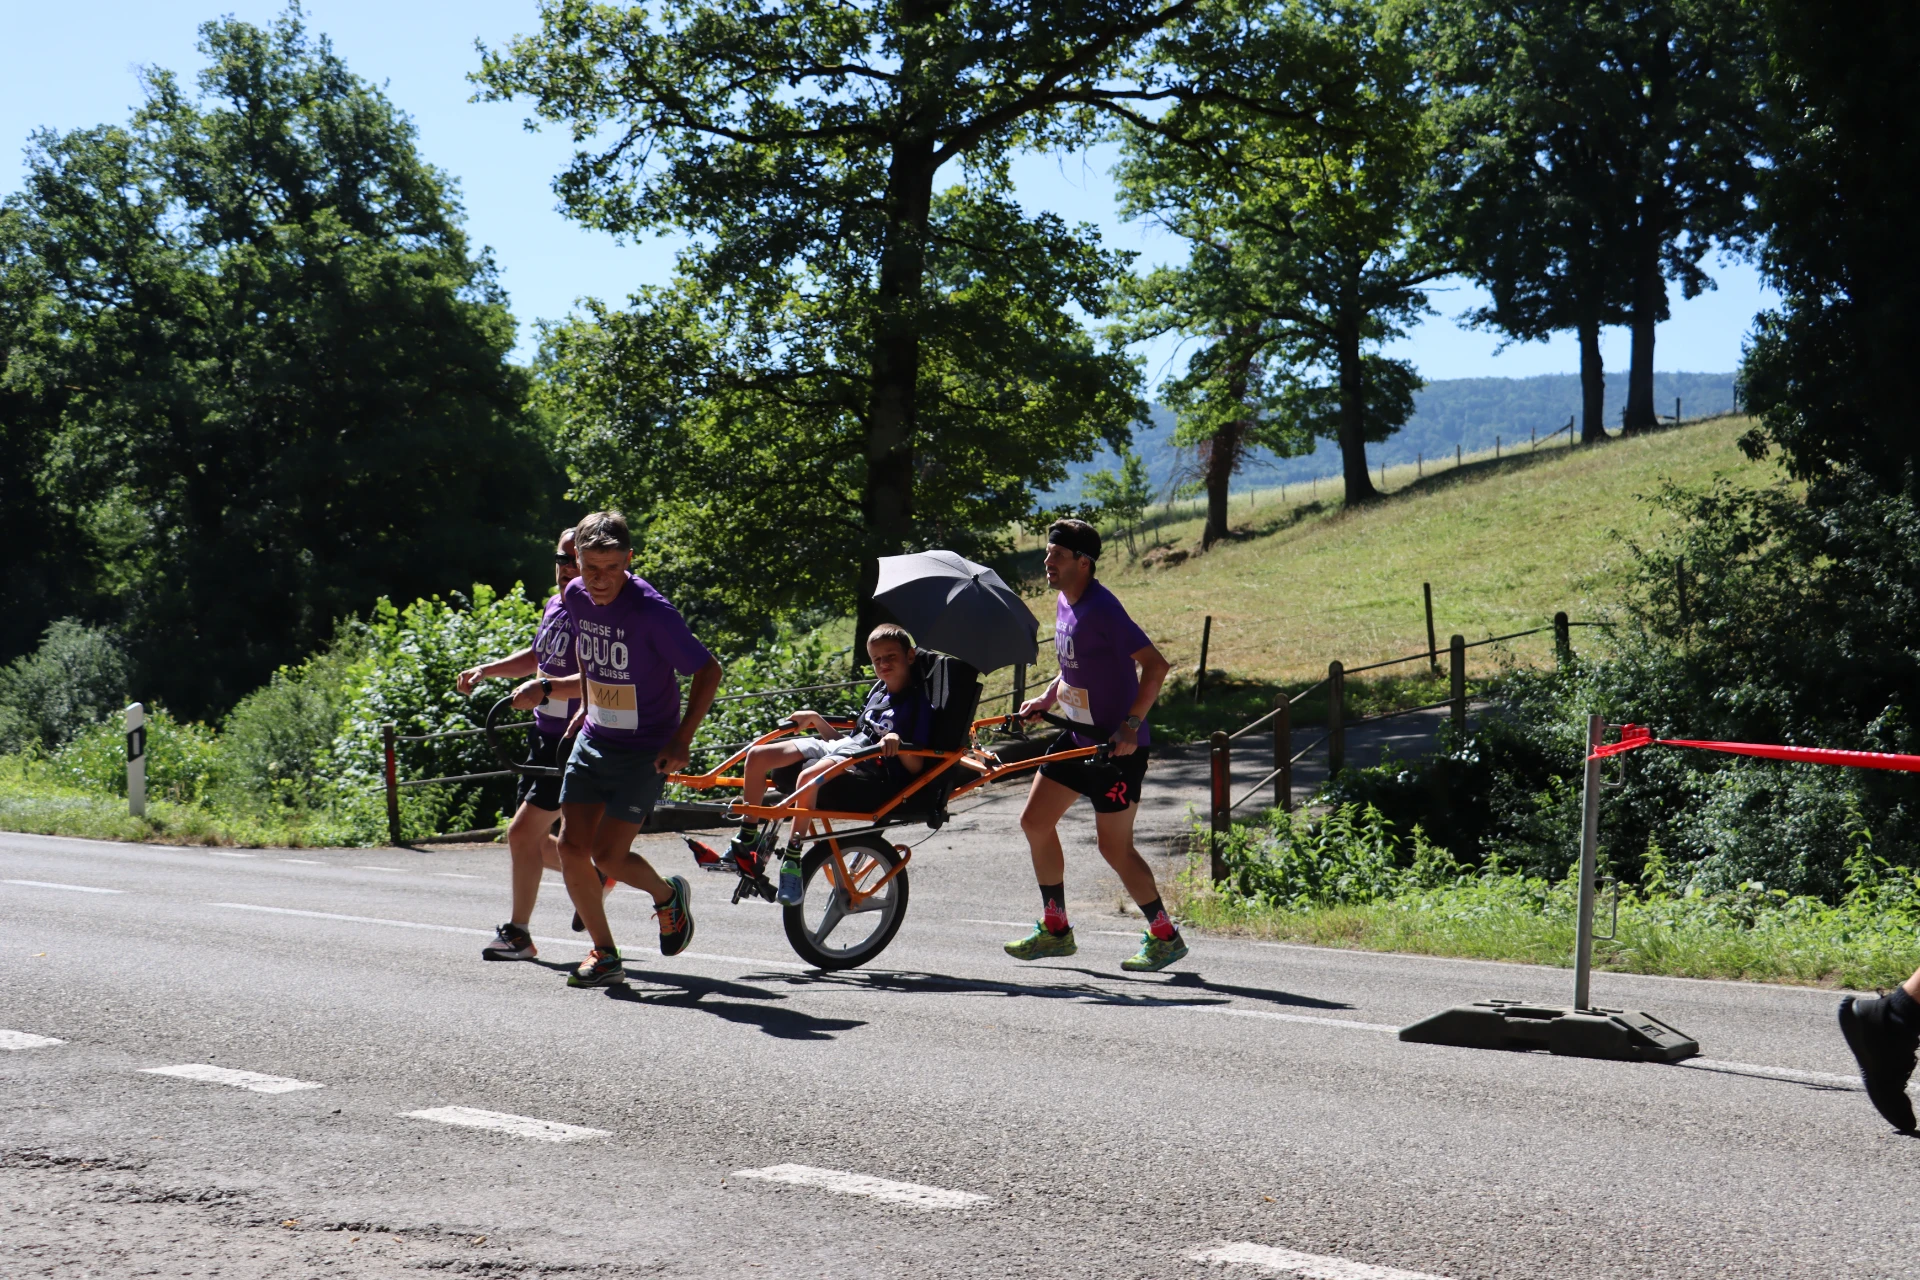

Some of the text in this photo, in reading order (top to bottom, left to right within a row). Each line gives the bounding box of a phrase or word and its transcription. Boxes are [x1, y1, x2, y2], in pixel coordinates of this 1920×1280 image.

[580, 619, 611, 637] COURSE
[581, 632, 629, 670] DUO
[599, 667, 631, 680] SUISSE
